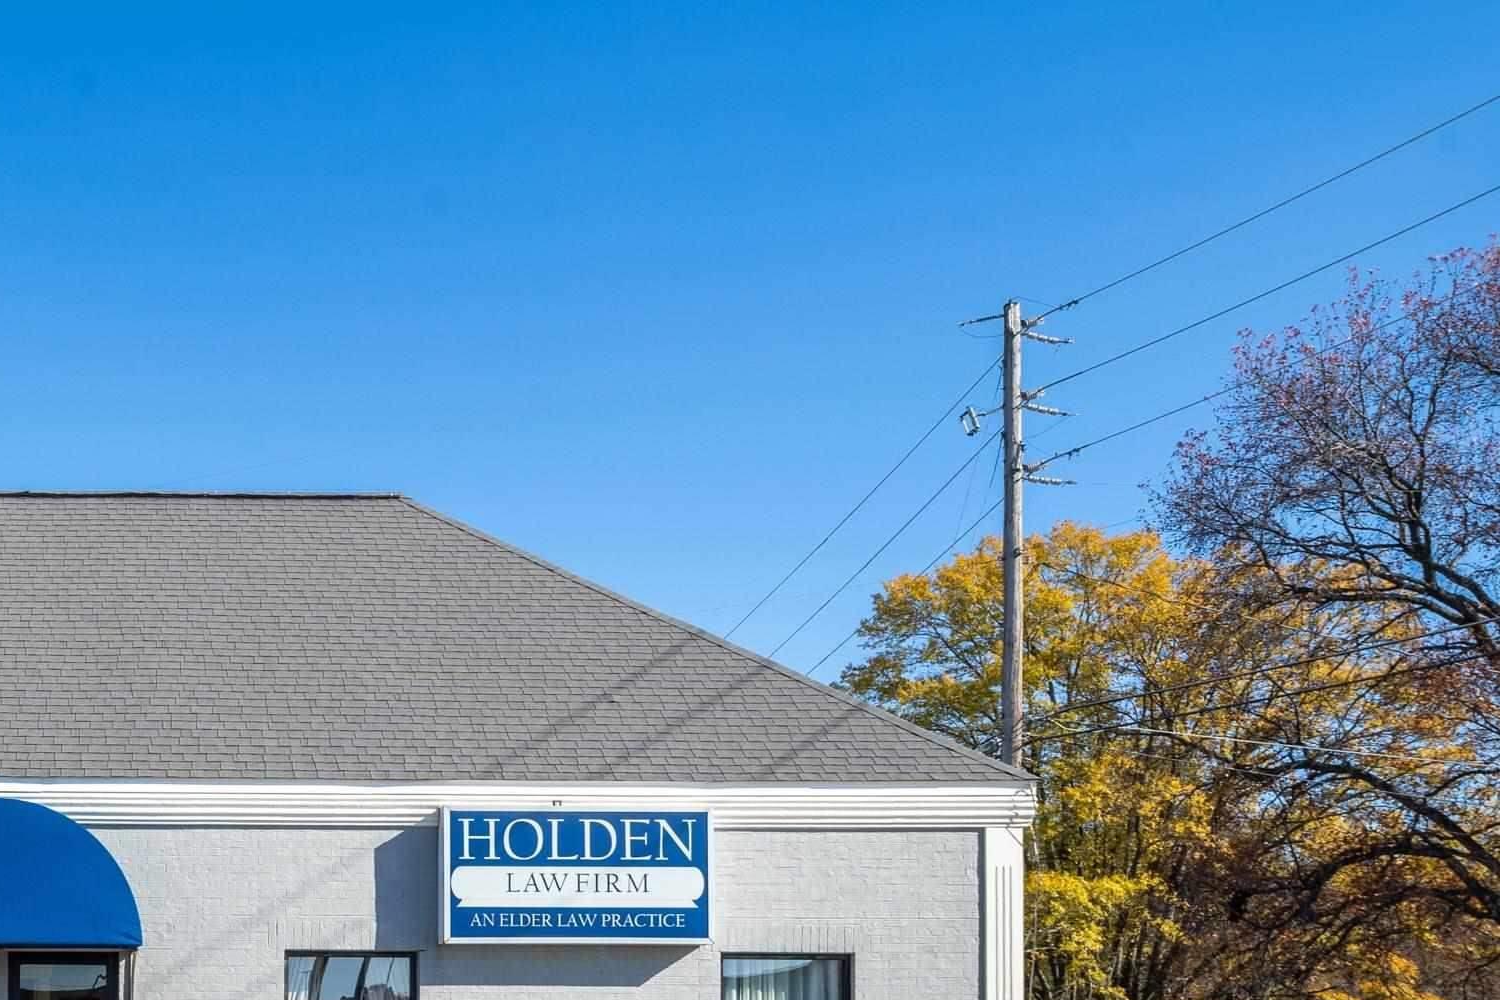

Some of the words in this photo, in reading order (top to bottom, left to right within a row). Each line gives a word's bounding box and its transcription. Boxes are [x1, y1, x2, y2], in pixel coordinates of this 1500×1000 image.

[457, 818, 696, 860] HOLDEN
[506, 872, 568, 893] LAW
[576, 873, 650, 893] FIRM
[470, 913, 495, 927] AN
[500, 913, 551, 927] ELDER
[557, 914, 598, 928] LAW
[602, 914, 685, 928] PRACTICE
